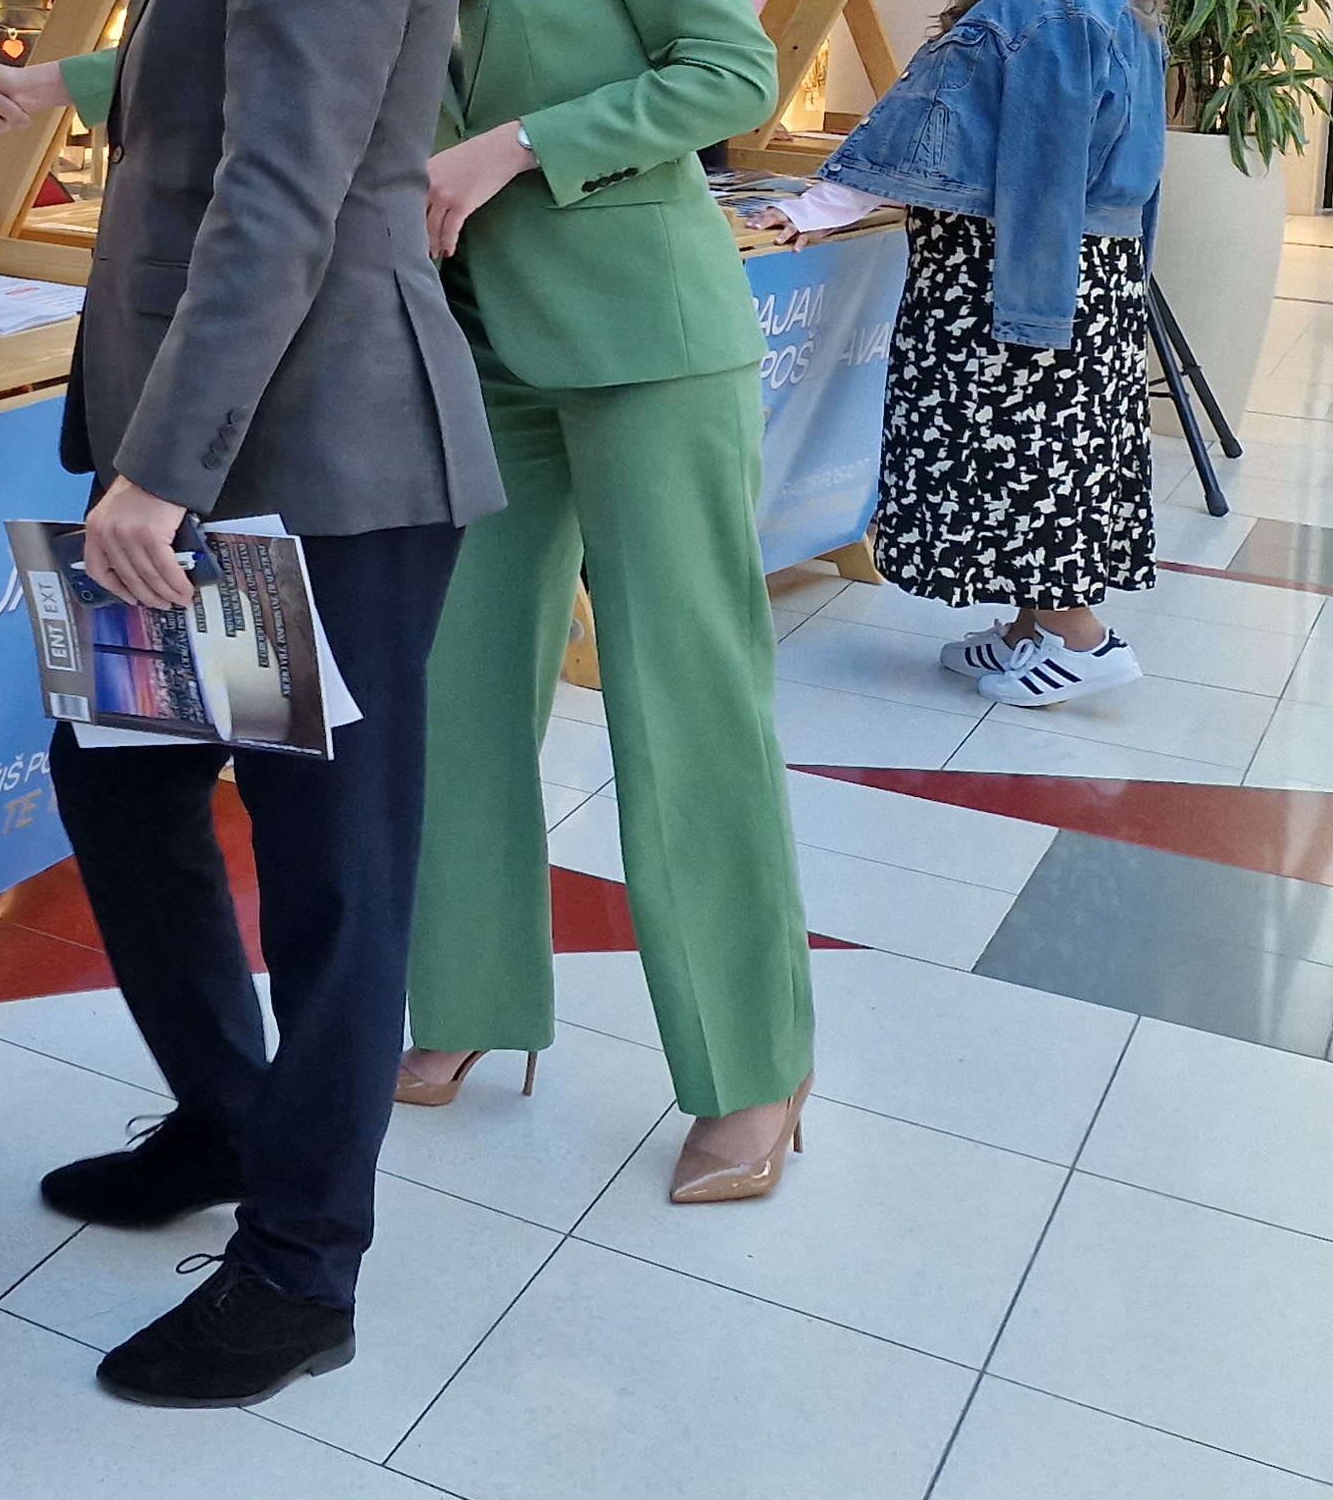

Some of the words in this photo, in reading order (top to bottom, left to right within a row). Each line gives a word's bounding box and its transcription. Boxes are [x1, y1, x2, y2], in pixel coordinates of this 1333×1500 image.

[38, 582, 58, 614] EXT
[47, 624, 68, 659] ENT
[1, 788, 43, 836] TE
